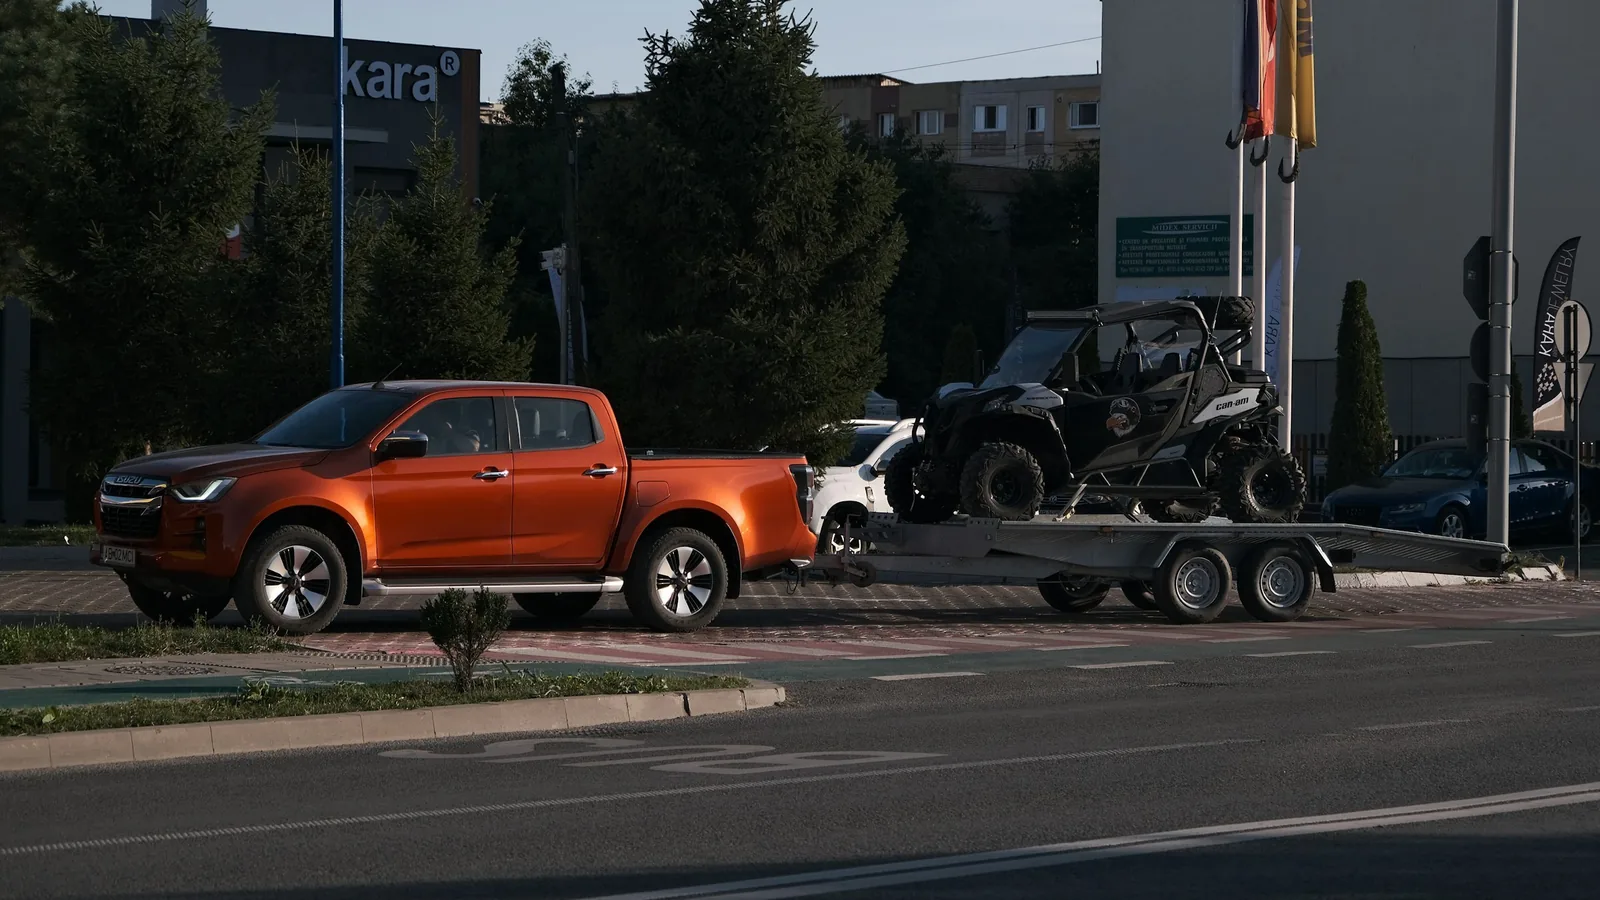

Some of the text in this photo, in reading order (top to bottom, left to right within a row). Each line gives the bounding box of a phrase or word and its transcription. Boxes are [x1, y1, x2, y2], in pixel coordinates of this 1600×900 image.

[342, 45, 436, 102] kara
[1215, 396, 1249, 411] can-am
[115, 476, 142, 484] ISUZU
